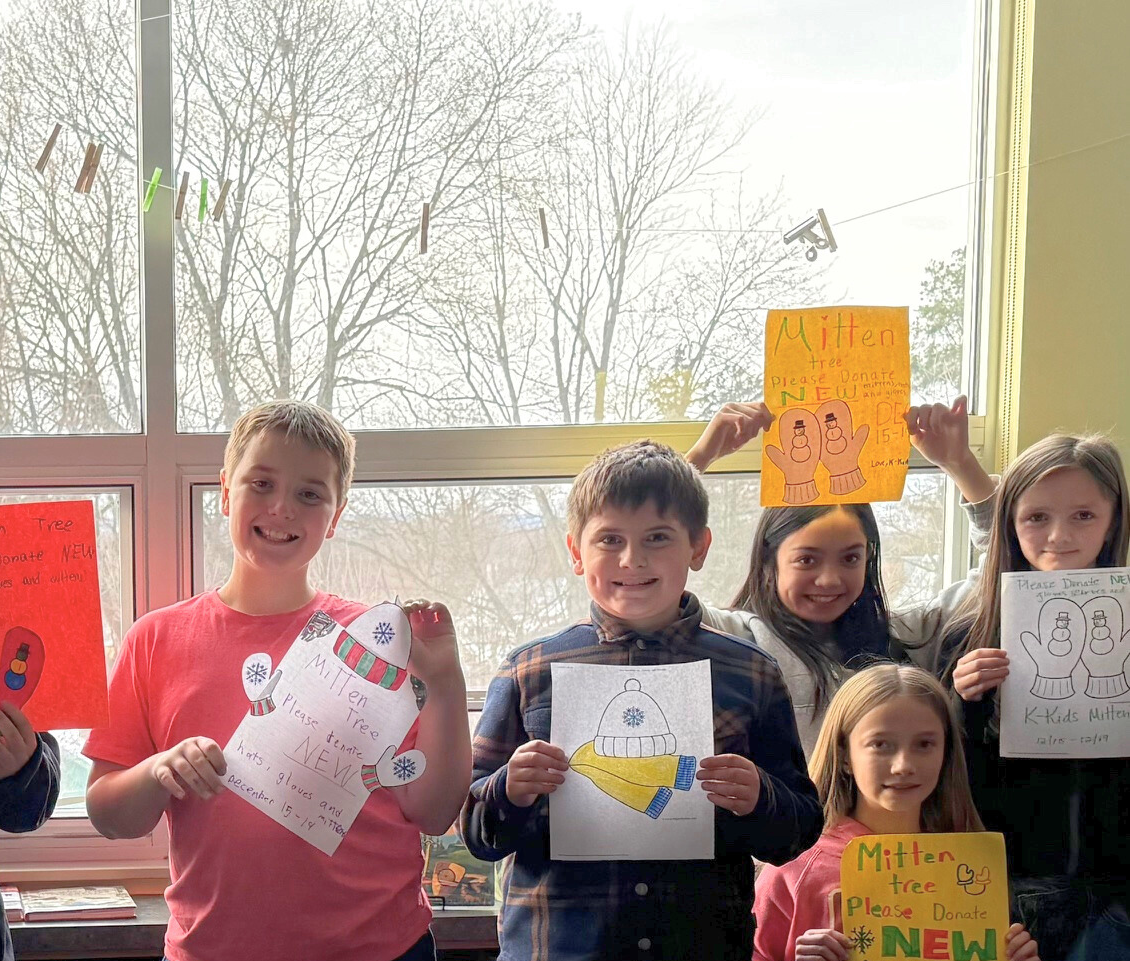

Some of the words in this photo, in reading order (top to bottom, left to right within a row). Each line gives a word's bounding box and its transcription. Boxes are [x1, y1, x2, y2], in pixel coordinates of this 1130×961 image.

[774, 312, 894, 356] Mitten
[809, 354, 842, 370] tree
[841, 369, 895, 384] Donate
[781, 384, 857, 406] NEW
[877, 424, 907, 444] 15-1
[32, 517, 74, 533] Tree
[61, 543, 95, 563] NEW
[1017, 579, 1056, 591] Please
[1062, 577, 1099, 589] Donate
[282, 692, 319, 730] Please
[1024, 706, 1078, 725] K-Kids
[342, 707, 380, 741] Tree
[294, 736, 360, 788] NEW
[276, 771, 312, 800] gloves
[319, 801, 343, 817] and
[857, 841, 955, 872] Mitten
[889, 873, 937, 894] tree
[847, 896, 913, 919] Please
[933, 903, 987, 921] Donate
[881, 925, 997, 961] NEW
